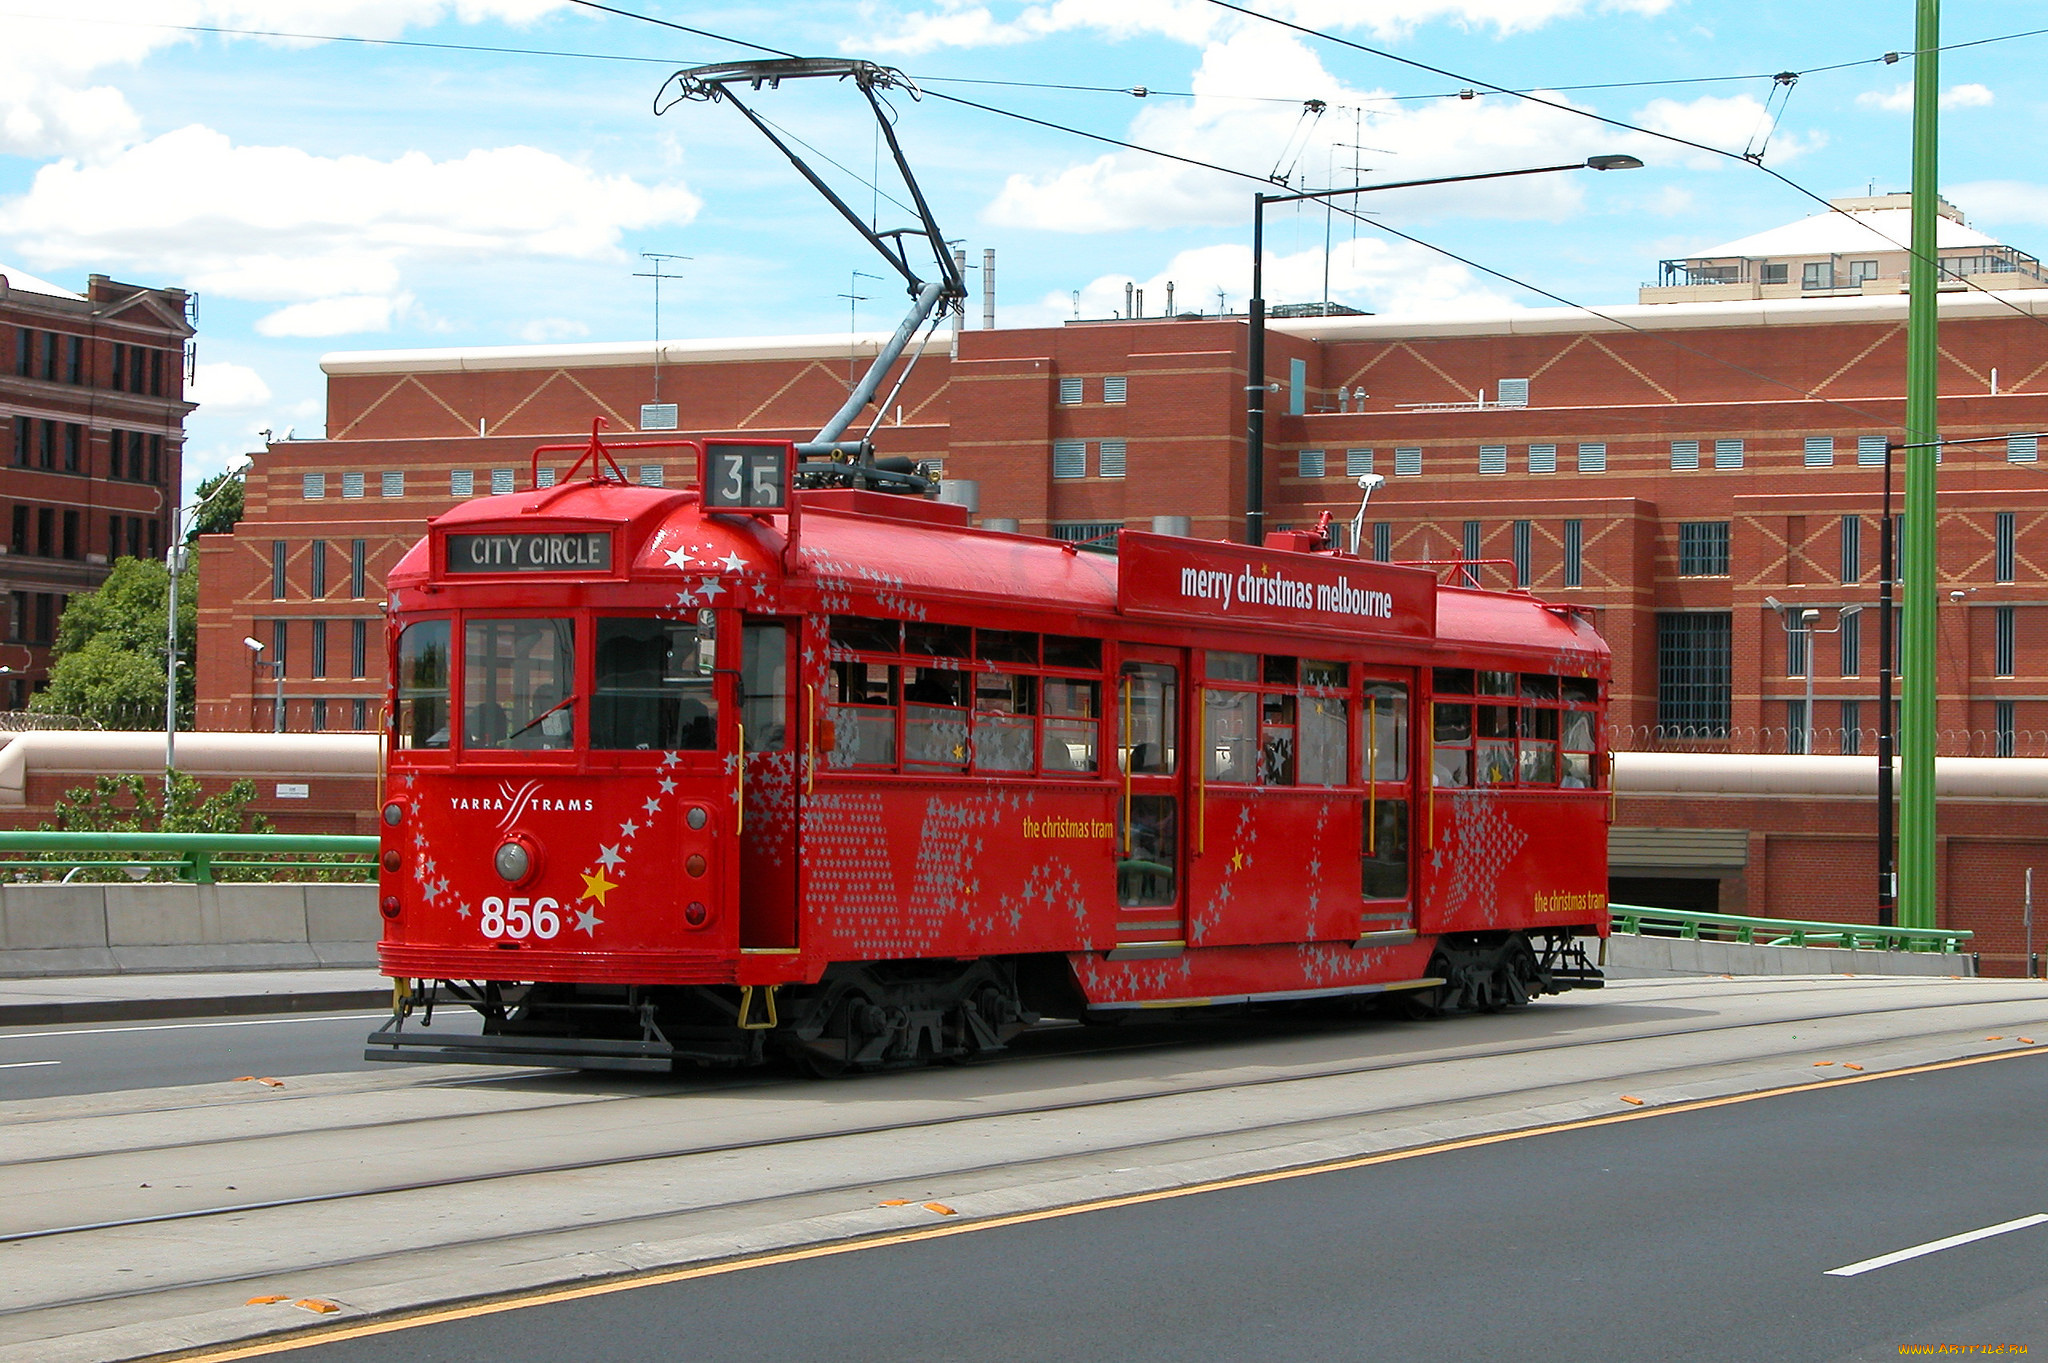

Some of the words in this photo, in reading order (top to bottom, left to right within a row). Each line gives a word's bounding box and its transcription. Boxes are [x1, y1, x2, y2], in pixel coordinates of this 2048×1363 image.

[722, 455, 777, 504] 35
[471, 538, 521, 564] CITY
[529, 537, 600, 564] CIRCLE
[1181, 566, 1233, 610] merry
[1237, 563, 1312, 609] christmas
[1317, 576, 1392, 618] melbourne
[451, 798, 503, 810] YARRA
[531, 799, 593, 811] TRAMS
[1023, 815, 1040, 838] the
[1041, 815, 1089, 838] christmas
[1091, 818, 1114, 838] tram
[1534, 890, 1548, 912] the
[1549, 889, 1587, 912] christmas
[1588, 890, 1605, 910] tram
[481, 896, 560, 939] 856
